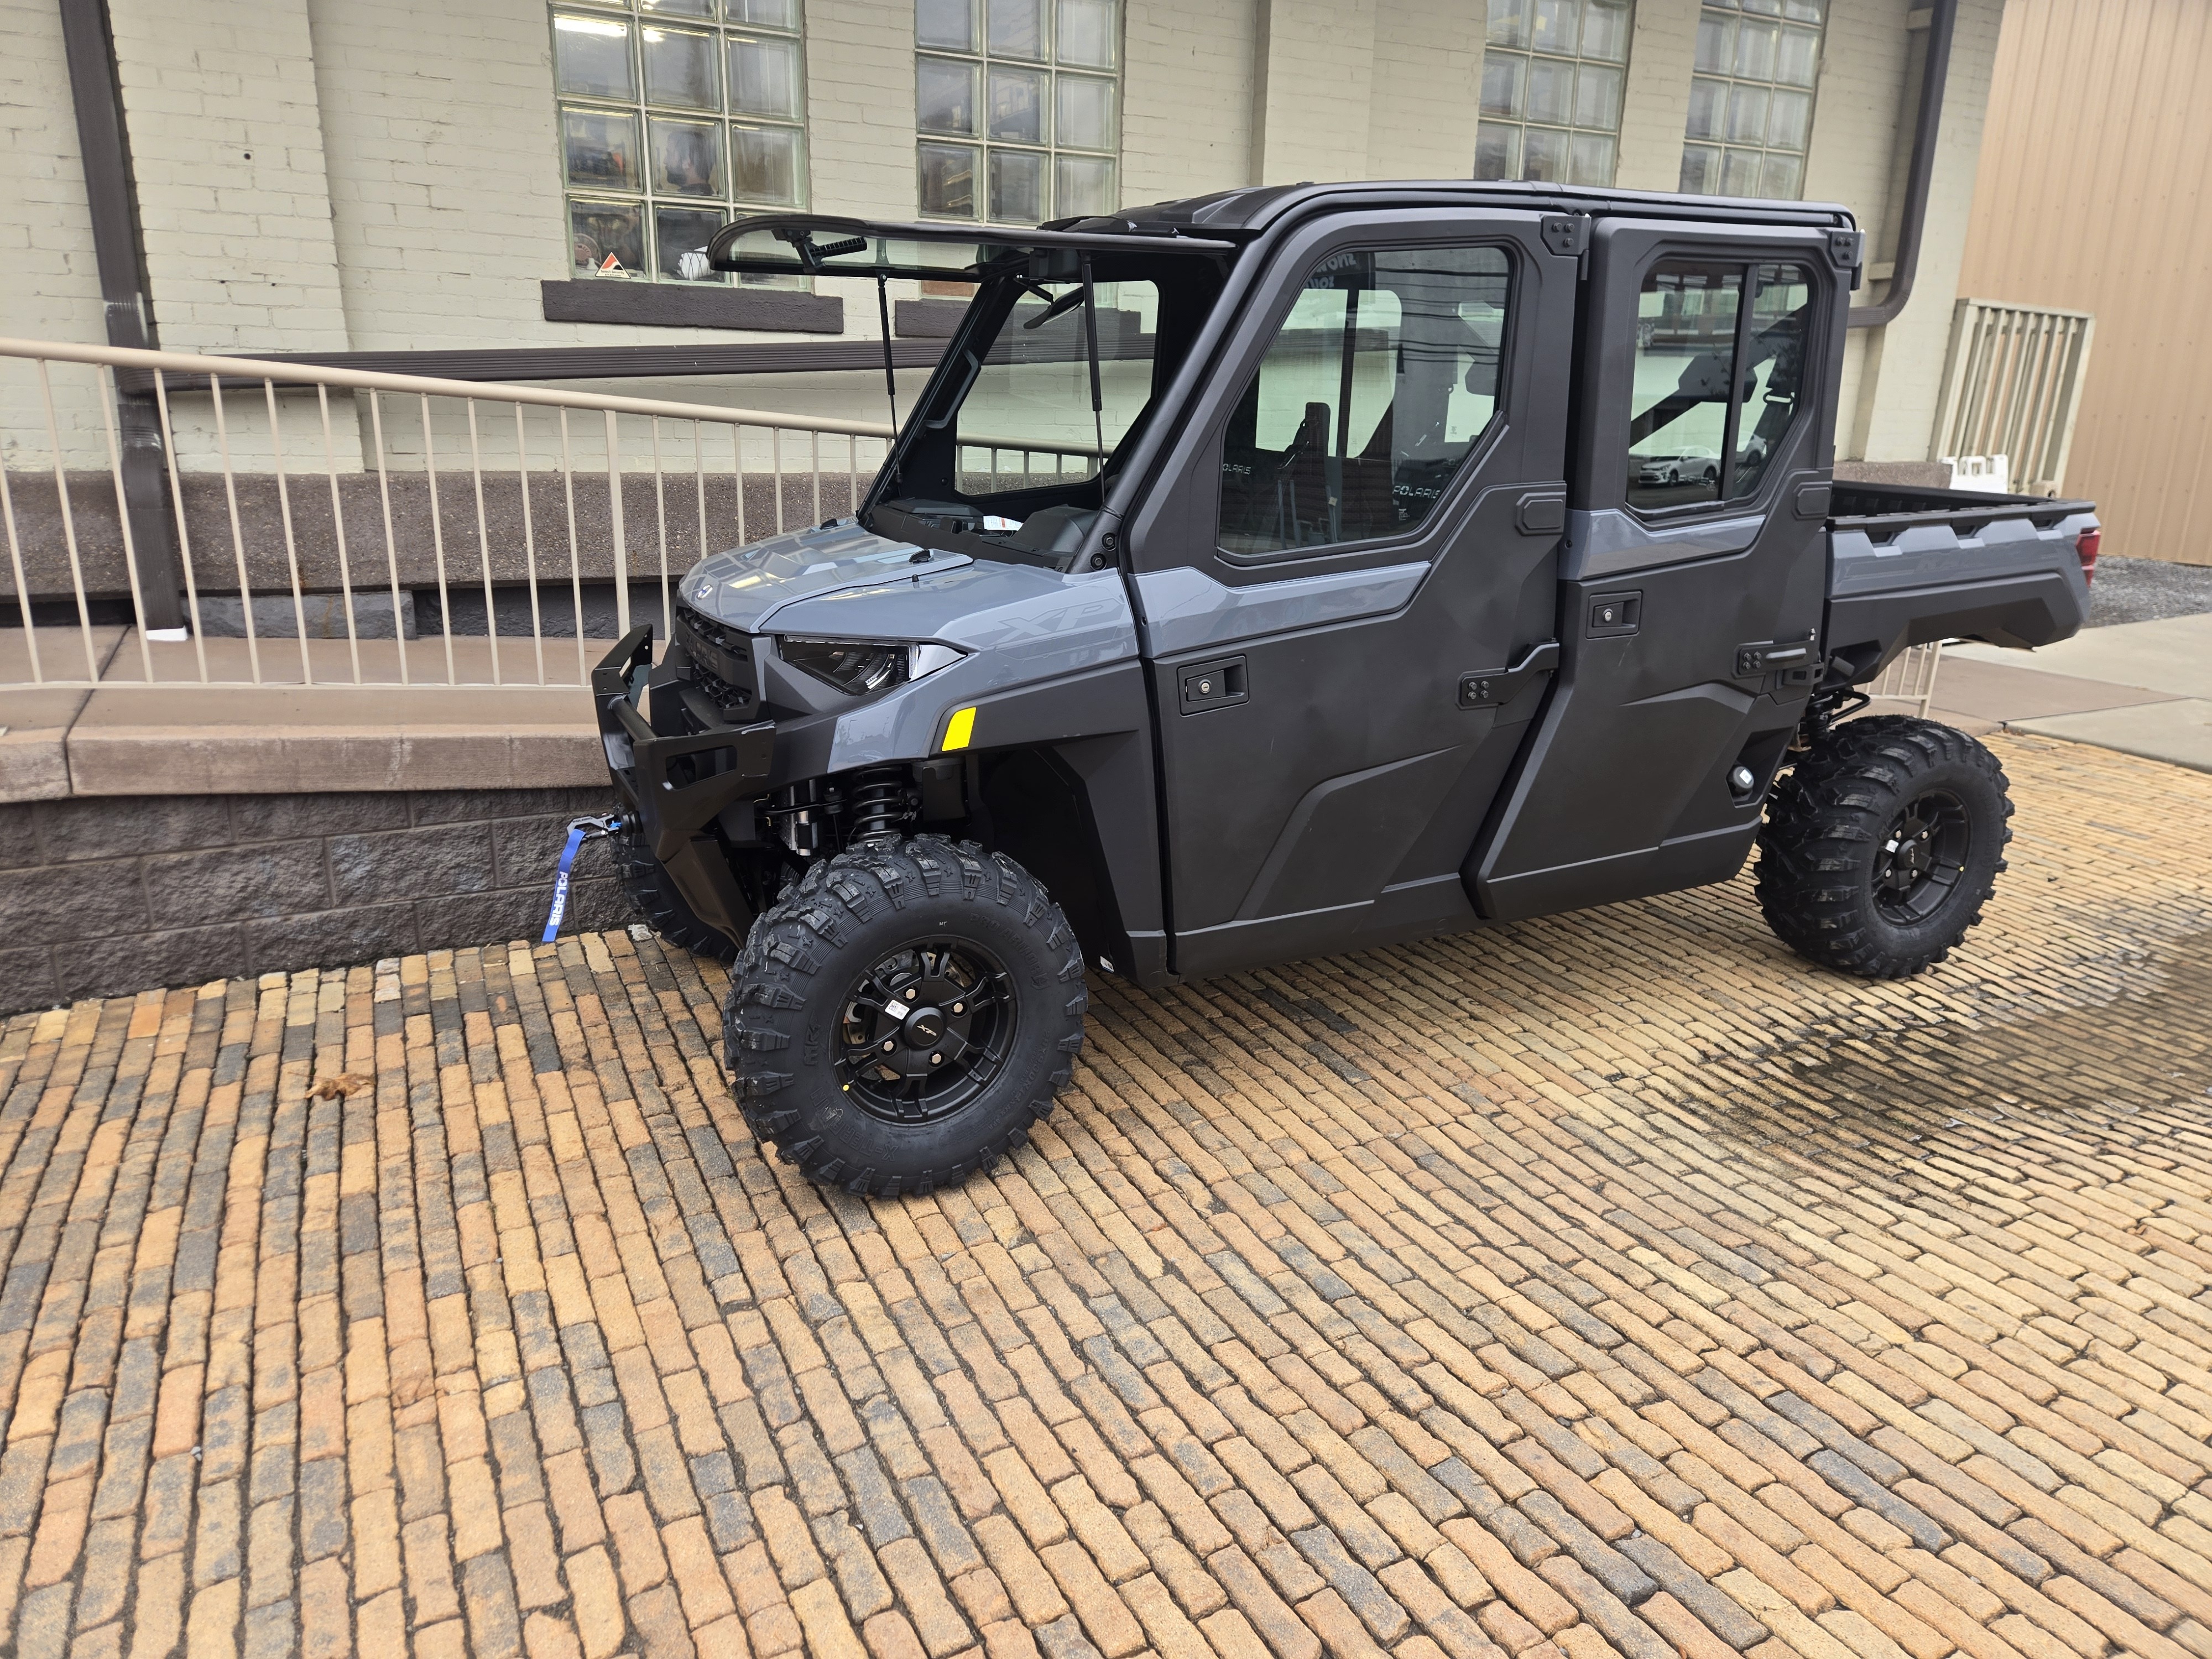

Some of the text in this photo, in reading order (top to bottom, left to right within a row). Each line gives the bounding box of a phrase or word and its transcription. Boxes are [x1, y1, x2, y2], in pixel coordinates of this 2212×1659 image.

[1222, 463, 1251, 475] OLARIS
[1391, 485, 1441, 499] POLARIS
[988, 597, 1124, 646] XP
[549, 871, 568, 926] POLARIS
[917, 1024, 937, 1036] XP
